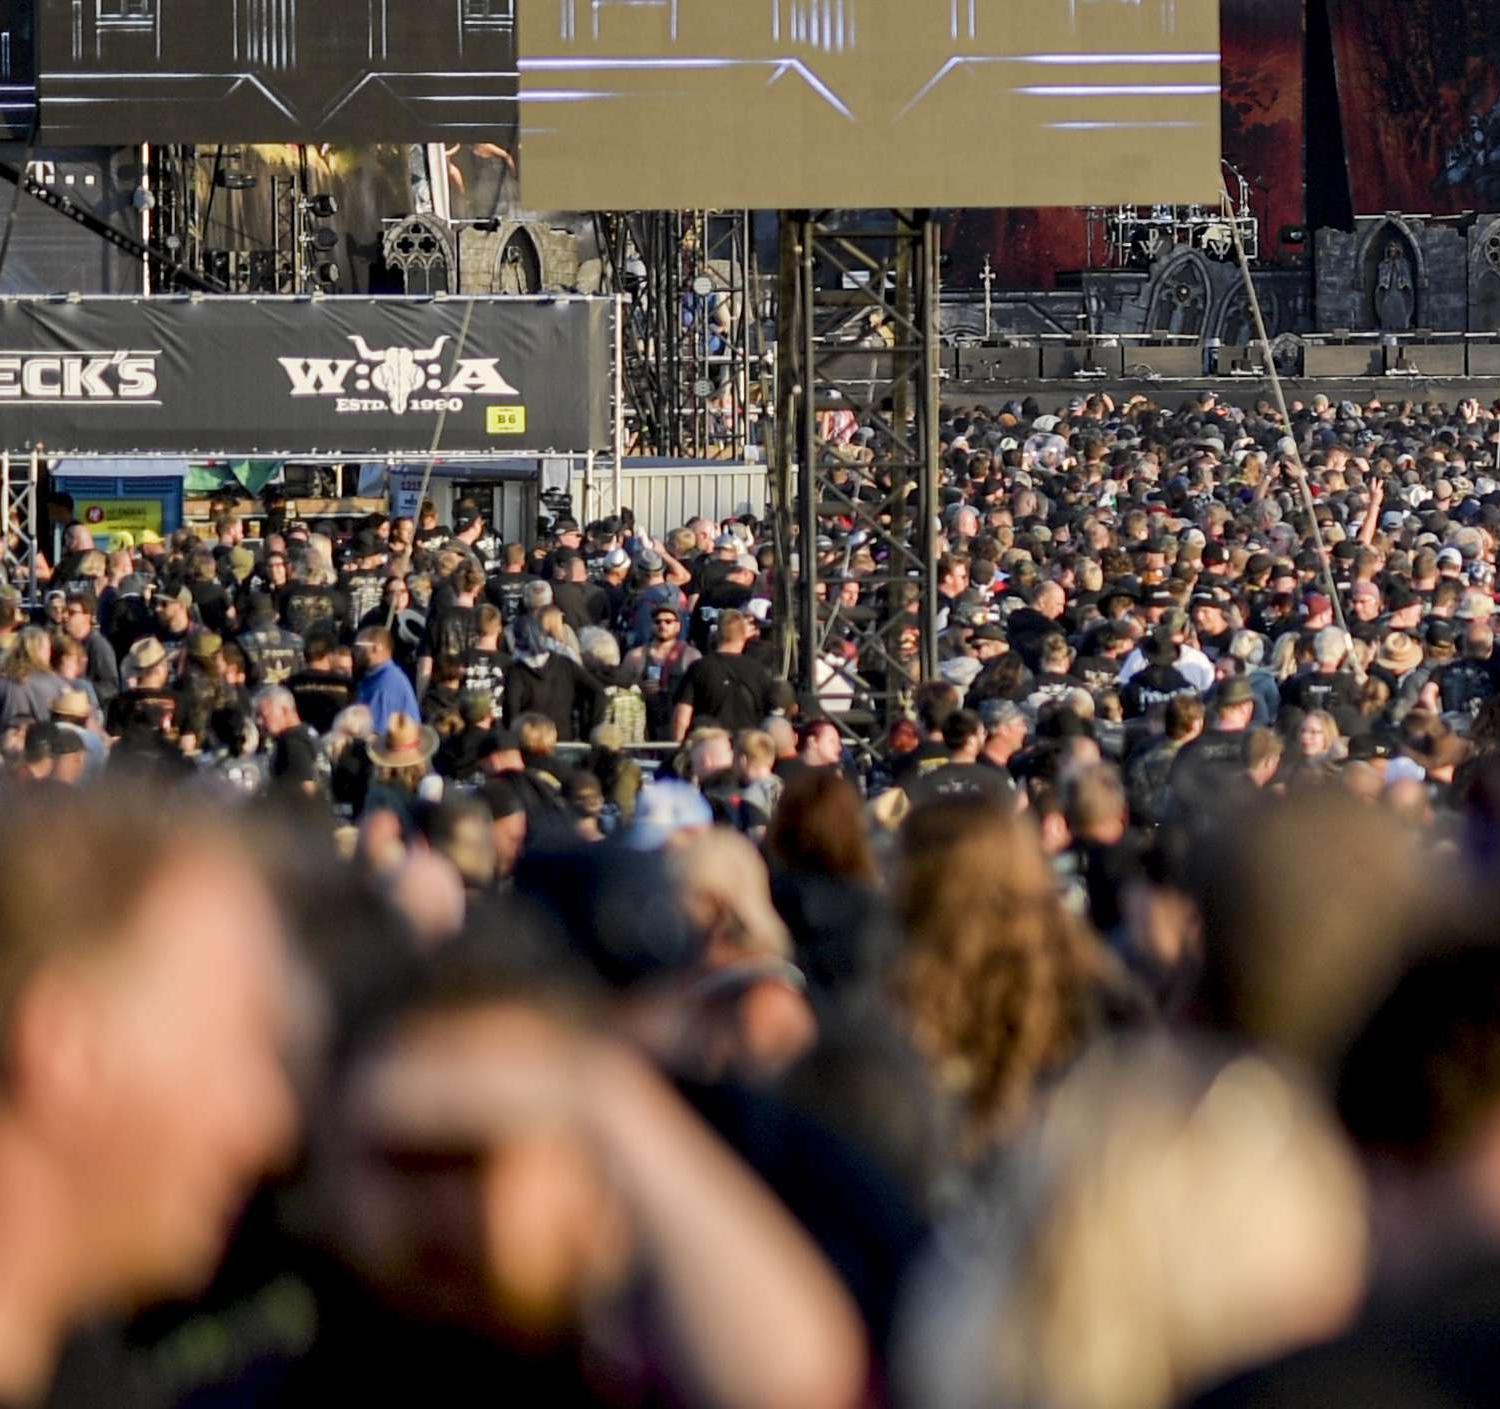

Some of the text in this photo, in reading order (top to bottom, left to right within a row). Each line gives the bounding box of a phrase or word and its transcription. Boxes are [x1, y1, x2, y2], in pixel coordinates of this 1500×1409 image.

[0, 351, 157, 396] ECK'S
[336, 398, 463, 411] ESTD. 1990
[497, 415, 516, 424] B 6
